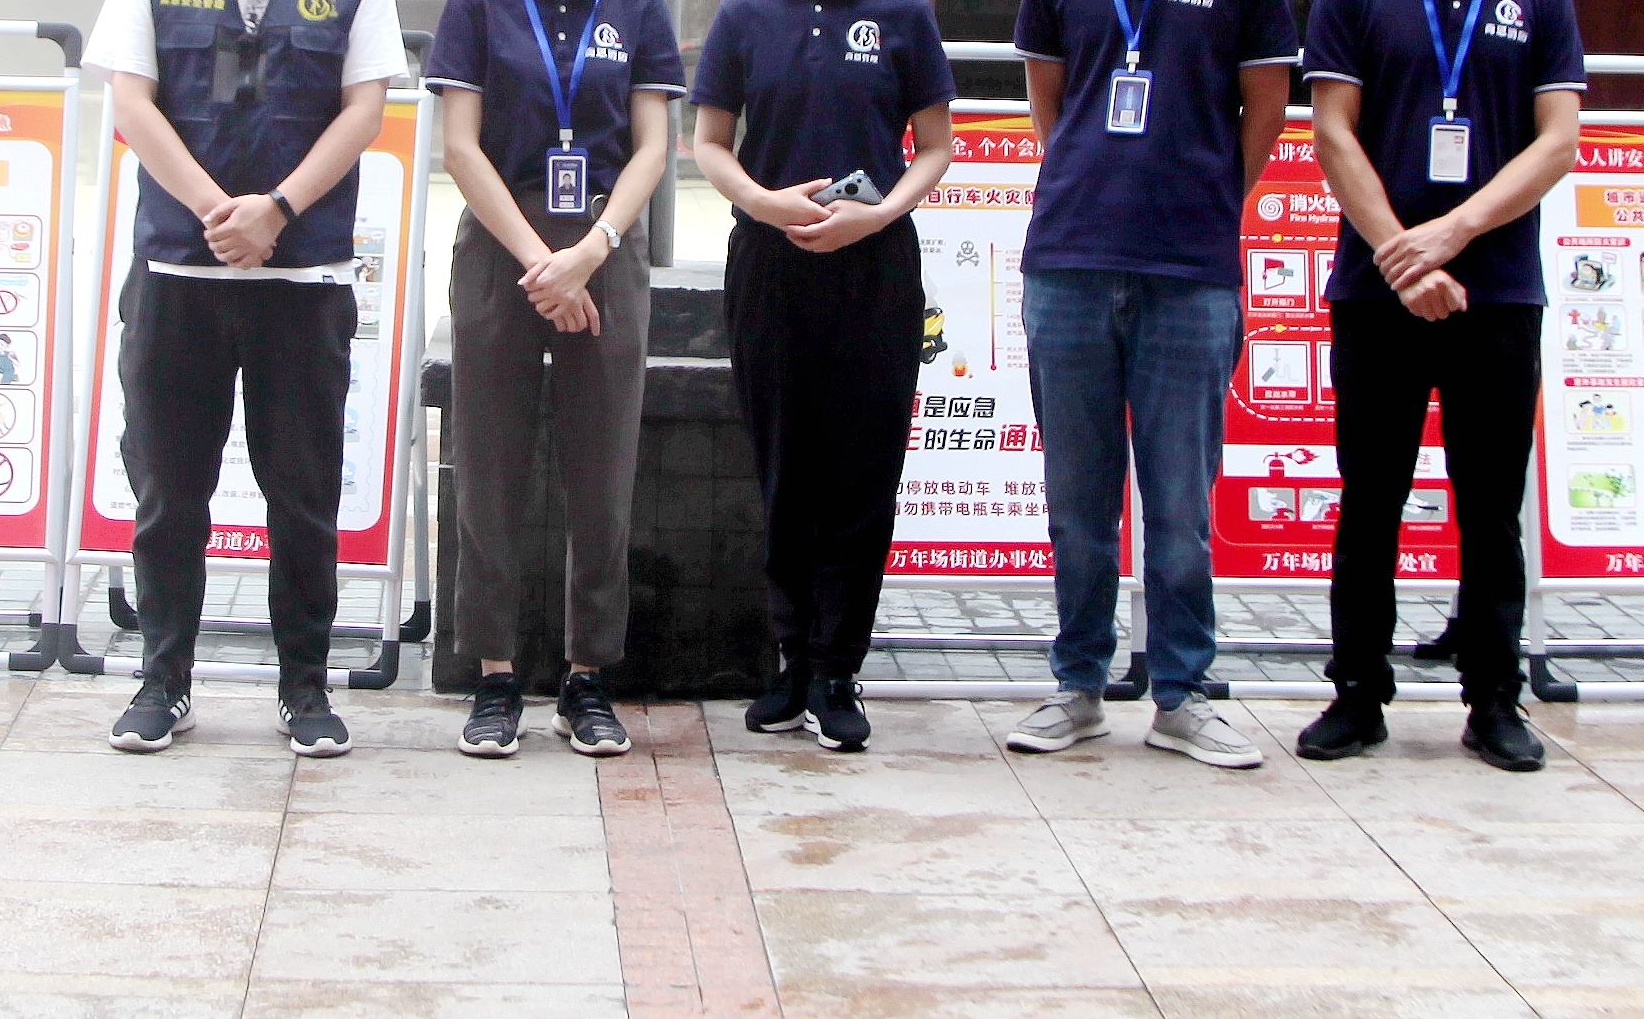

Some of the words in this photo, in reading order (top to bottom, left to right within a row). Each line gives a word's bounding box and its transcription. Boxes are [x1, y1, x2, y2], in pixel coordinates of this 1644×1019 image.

[890, 548, 1055, 569] 万年场街道办事处
